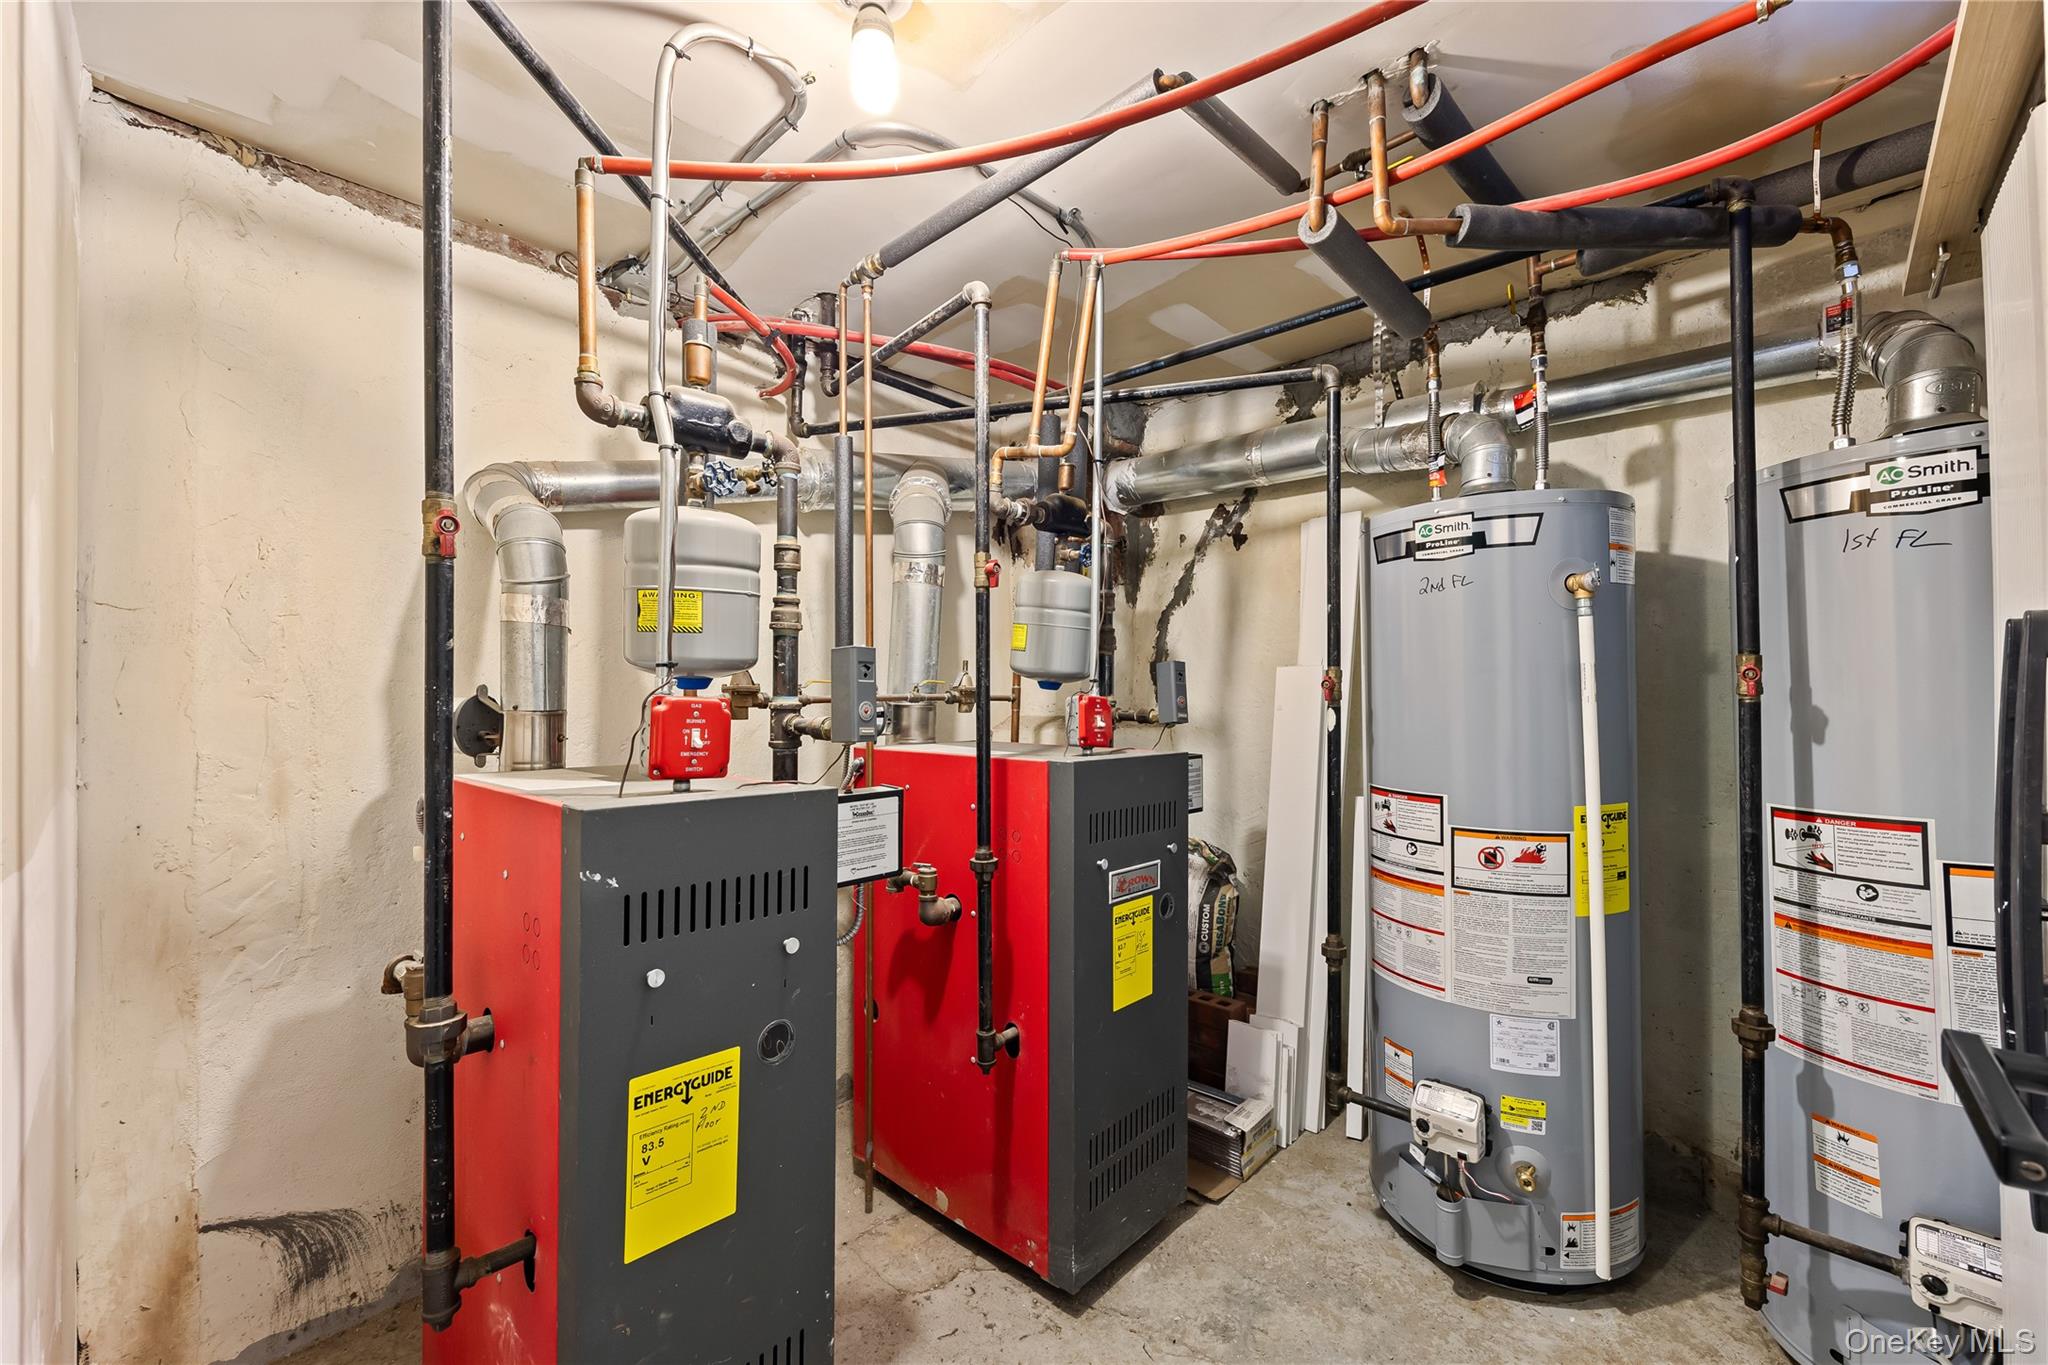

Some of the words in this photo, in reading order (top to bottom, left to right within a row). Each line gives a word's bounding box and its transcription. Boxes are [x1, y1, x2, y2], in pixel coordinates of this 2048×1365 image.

[1890, 484, 1953, 499] ProLine
[1882, 499, 1932, 510] COMMERCIAL
[1935, 496, 1962, 504] GRADE
[1425, 539, 1459, 549] ProLine
[1842, 528, 1879, 553] 1st
[1895, 529, 1953, 550] FL
[1452, 574, 1474, 589] FL
[1825, 818, 1857, 827] DANGER
[1115, 906, 1150, 925] ENERGYGUIDE
[1201, 903, 1211, 941] CUSTOM
[633, 1066, 733, 1111] ENERGYGUIDE
[641, 1137, 665, 1154] 83.5
[642, 1155, 651, 1166] V
